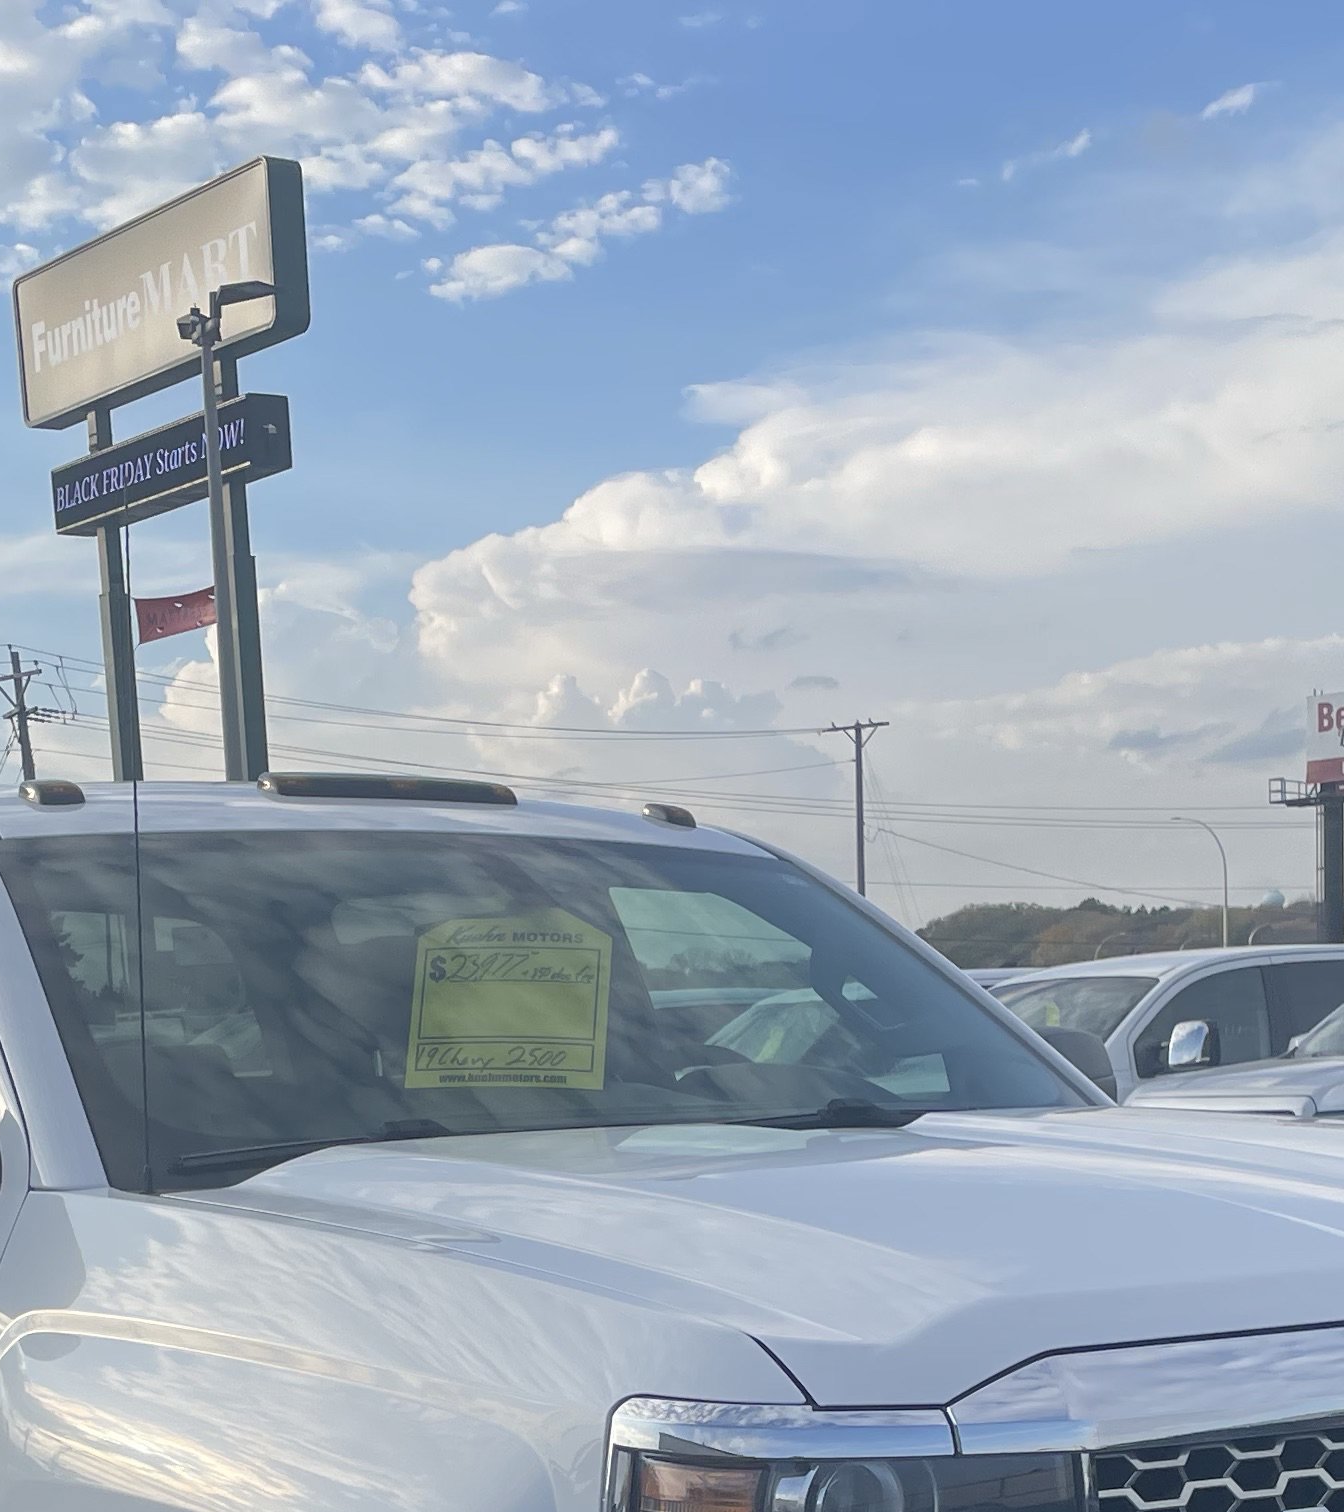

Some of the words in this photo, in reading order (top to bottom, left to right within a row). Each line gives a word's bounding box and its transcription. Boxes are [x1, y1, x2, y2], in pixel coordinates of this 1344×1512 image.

[56, 472, 99, 512] BLACK
[102, 452, 154, 493] FRIDAY
[156, 438, 197, 473] Starts
[512, 932, 584, 944] MOTORS
[439, 1047, 495, 1072] Chevy
[505, 1046, 567, 1067] 2500
